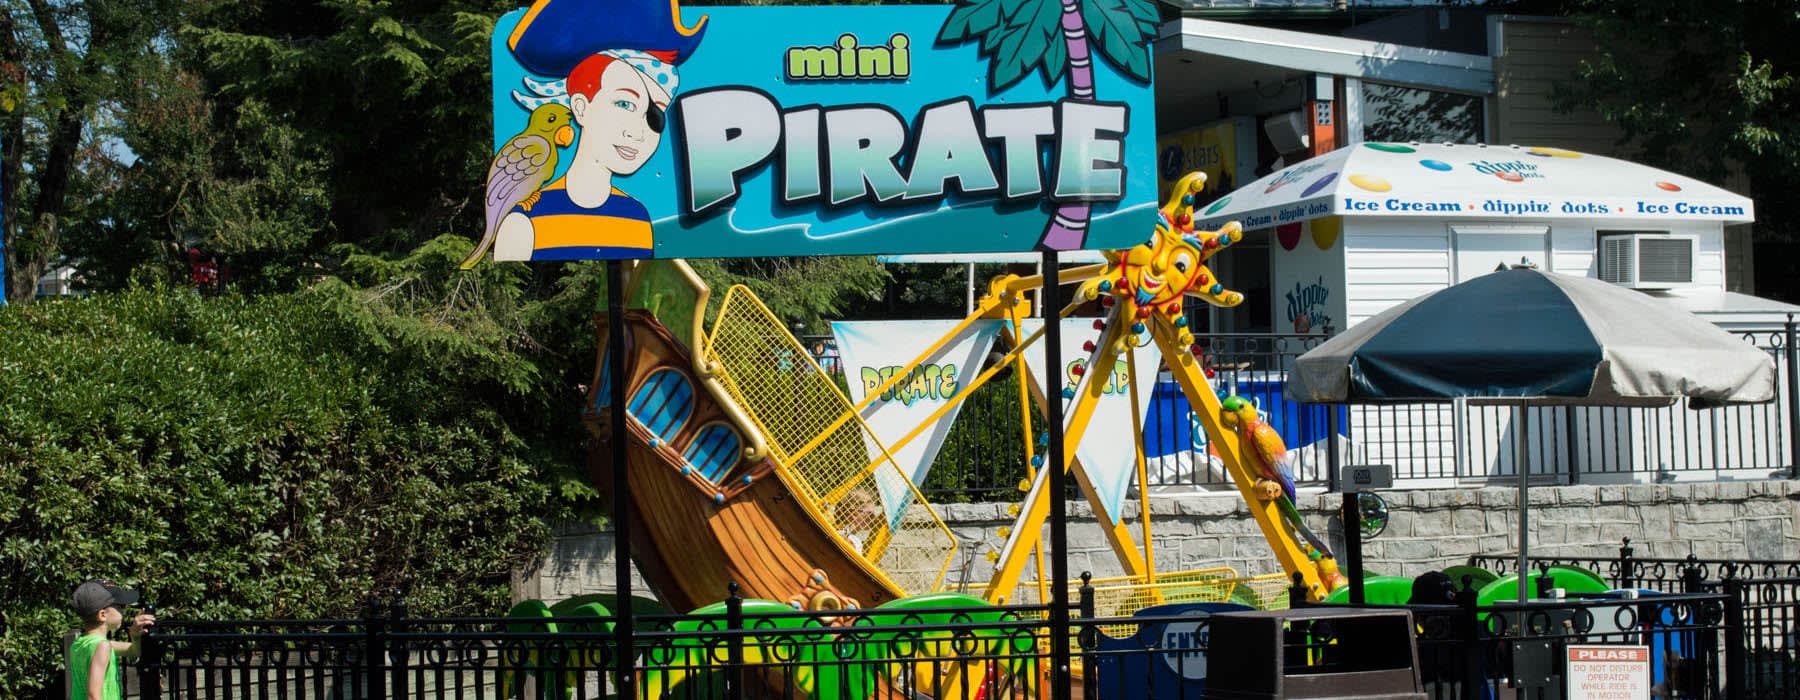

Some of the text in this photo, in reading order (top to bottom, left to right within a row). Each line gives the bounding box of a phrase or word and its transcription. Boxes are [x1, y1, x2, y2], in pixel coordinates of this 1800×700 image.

[787, 33, 910, 80] mini
[676, 87, 1129, 214] PIRATE
[1309, 203, 1328, 213] dots
[1344, 198, 1379, 211] Ice
[1385, 199, 1462, 212] Cream
[1561, 201, 1609, 214] dots
[1637, 201, 1669, 213] Ice
[1675, 202, 1744, 215] Cream
[861, 364, 957, 406] PIRATE
[1578, 650, 1638, 660] PLEASE
[1573, 664, 1643, 673] DO NOT DISTURB
[1587, 673, 1631, 681] OPERATOR
